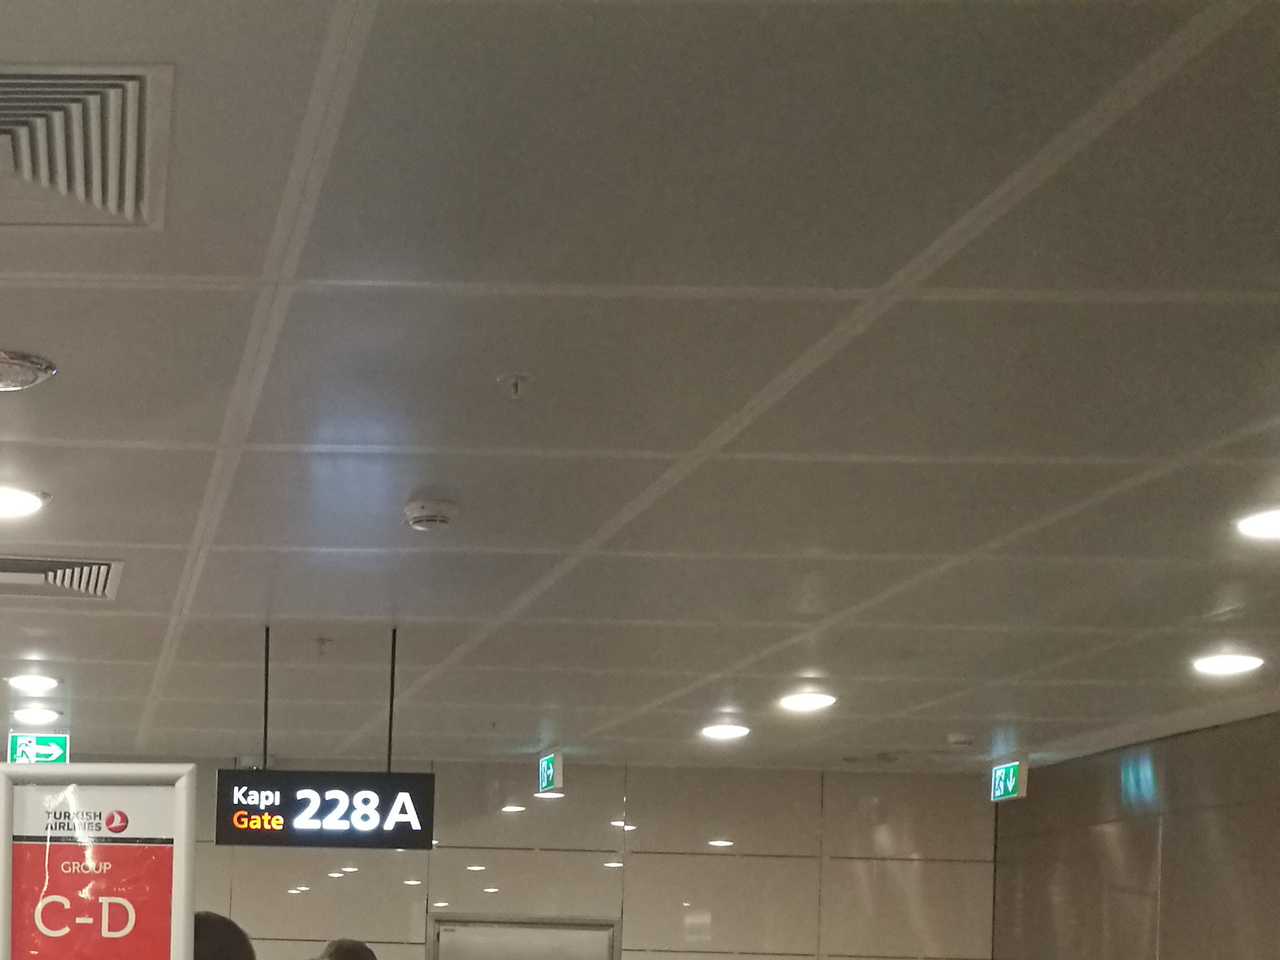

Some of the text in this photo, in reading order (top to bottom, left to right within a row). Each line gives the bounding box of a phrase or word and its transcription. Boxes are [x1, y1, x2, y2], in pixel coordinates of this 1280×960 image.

[233, 786, 280, 809] Kapı
[232, 810, 284, 831] Gate
[293, 788, 422, 831] 228A
[61, 861, 111, 874] GROUP
[34, 894, 136, 939] C-D
